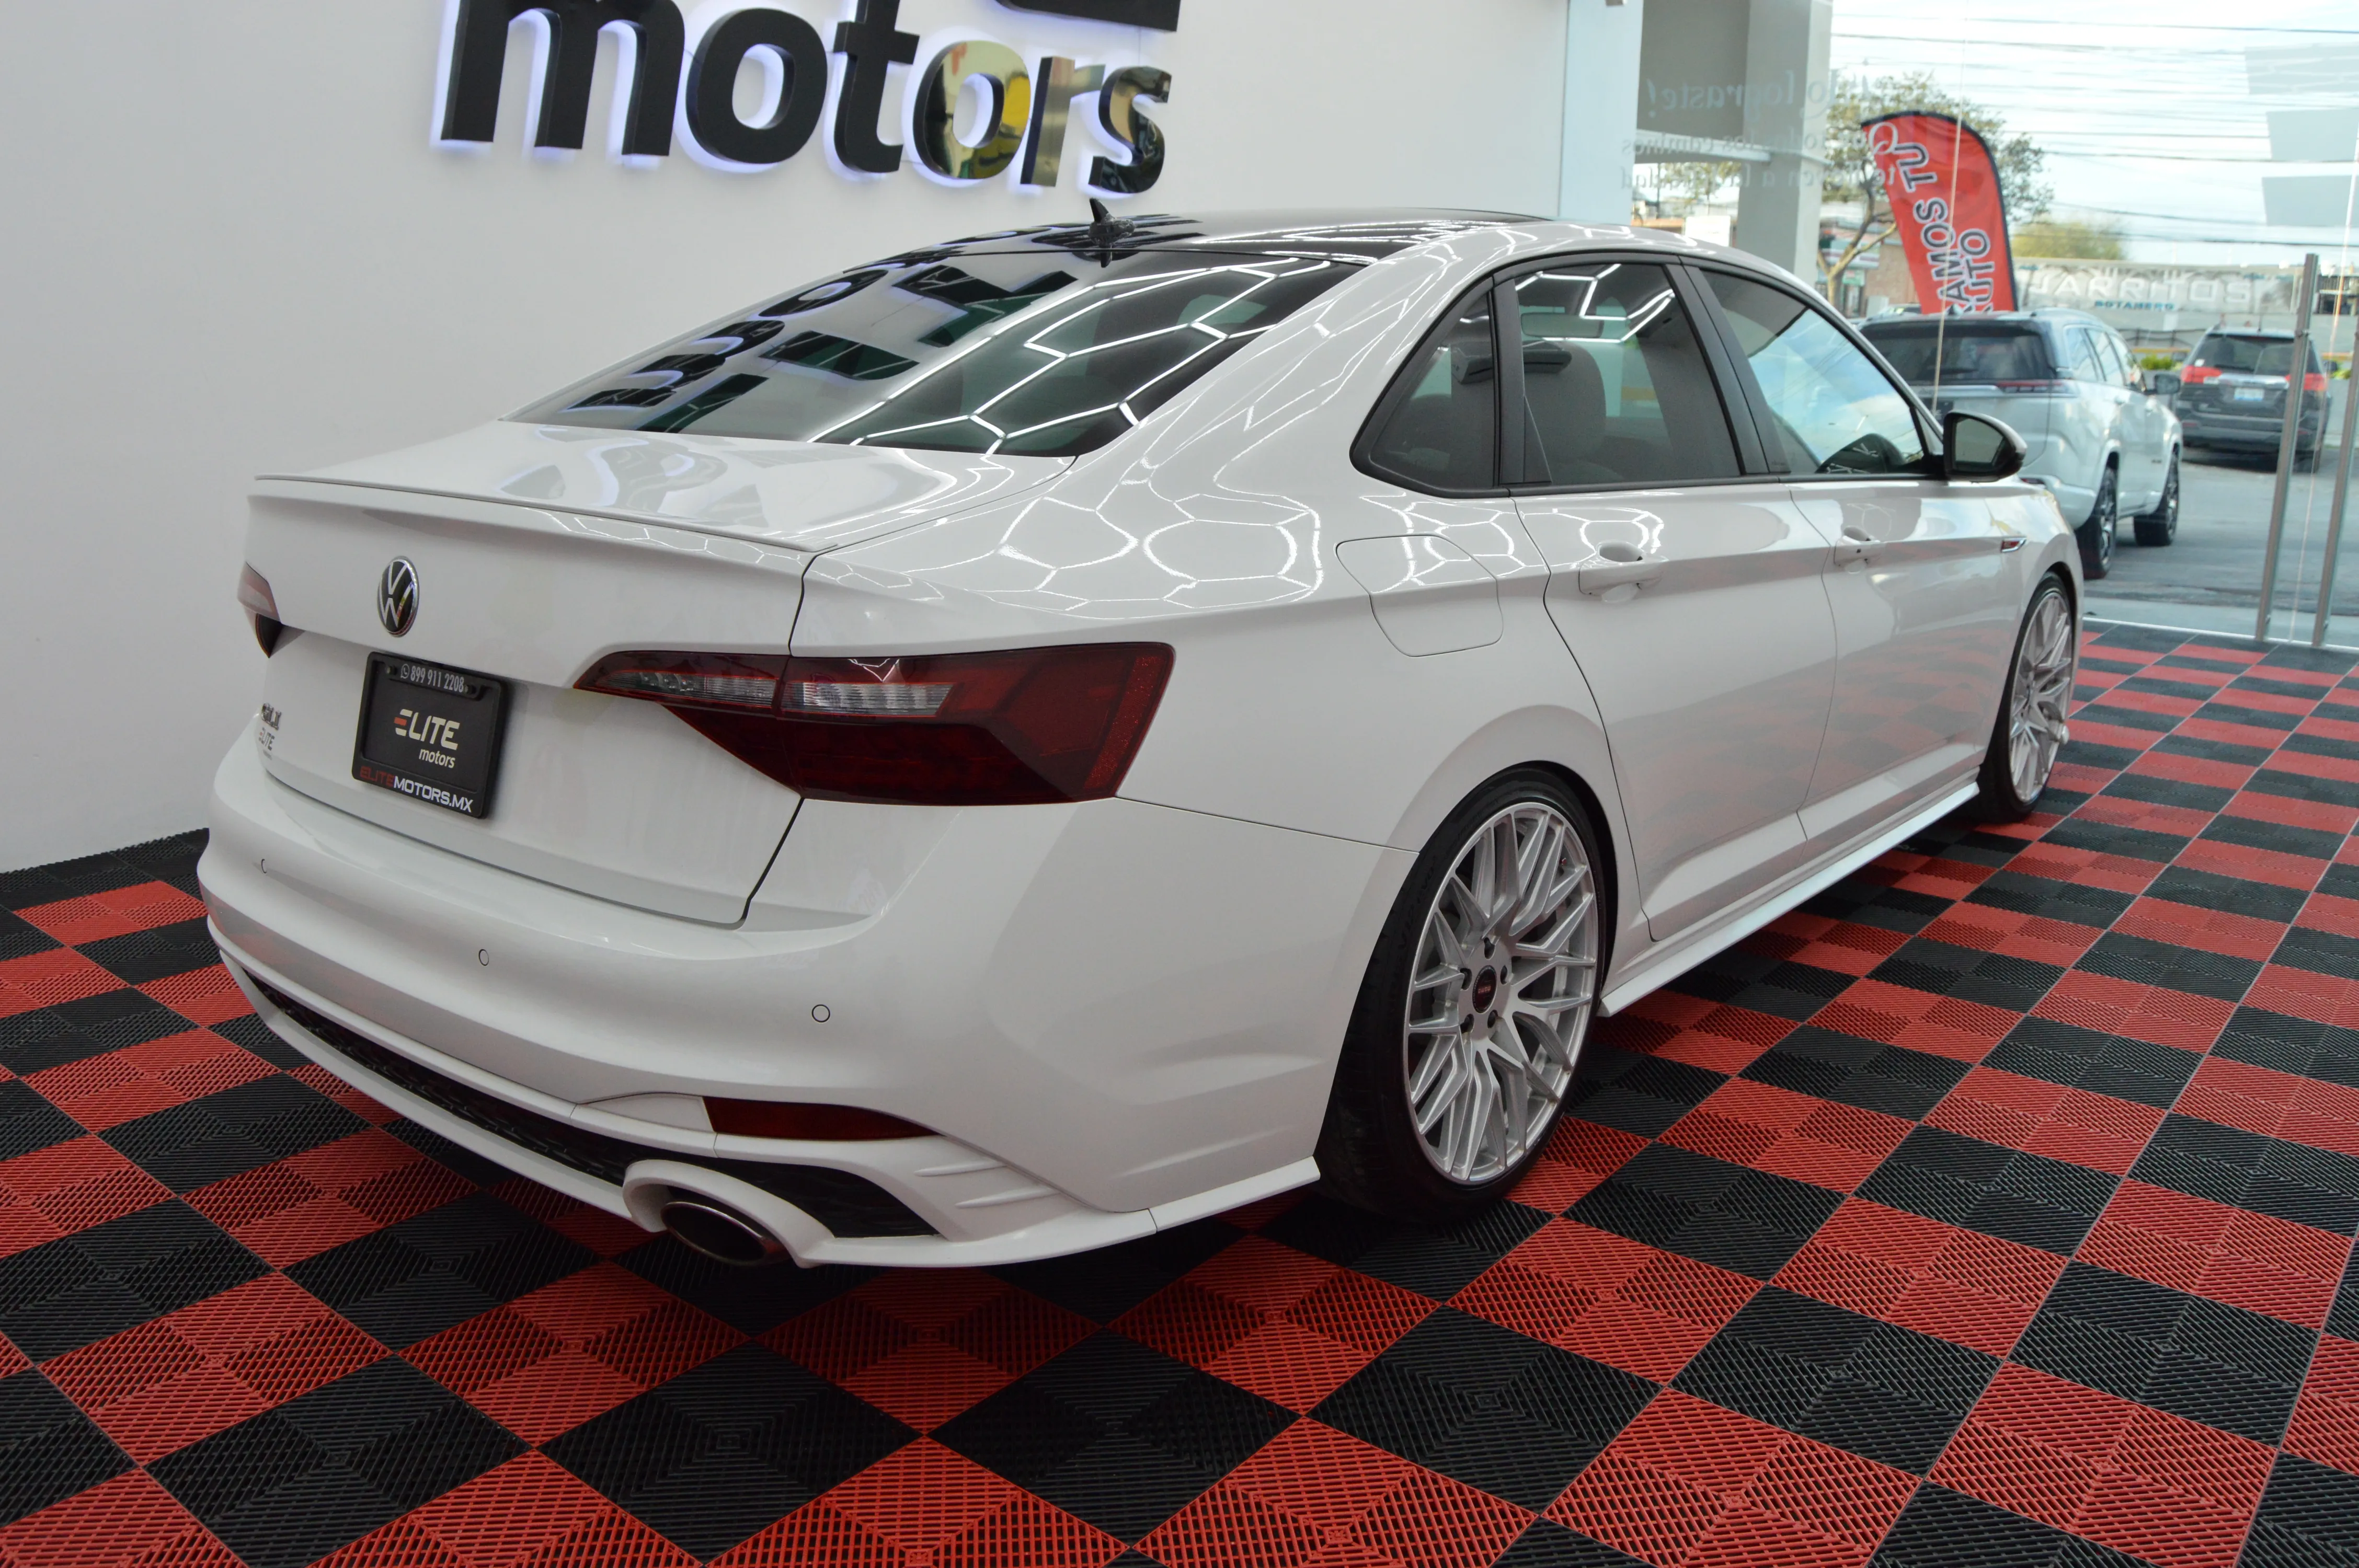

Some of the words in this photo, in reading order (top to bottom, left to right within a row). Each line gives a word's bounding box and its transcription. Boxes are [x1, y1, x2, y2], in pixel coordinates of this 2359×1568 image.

[441, 0, 1172, 195] motors
[1896, 142, 1937, 192] TU
[2029, 274, 2252, 304] JARRITOS
[410, 665, 426, 683] 899
[428, 669, 442, 687] 911
[443, 673, 464, 693] 2208
[394, 709, 460, 751] ELITE
[419, 748, 456, 769] motors
